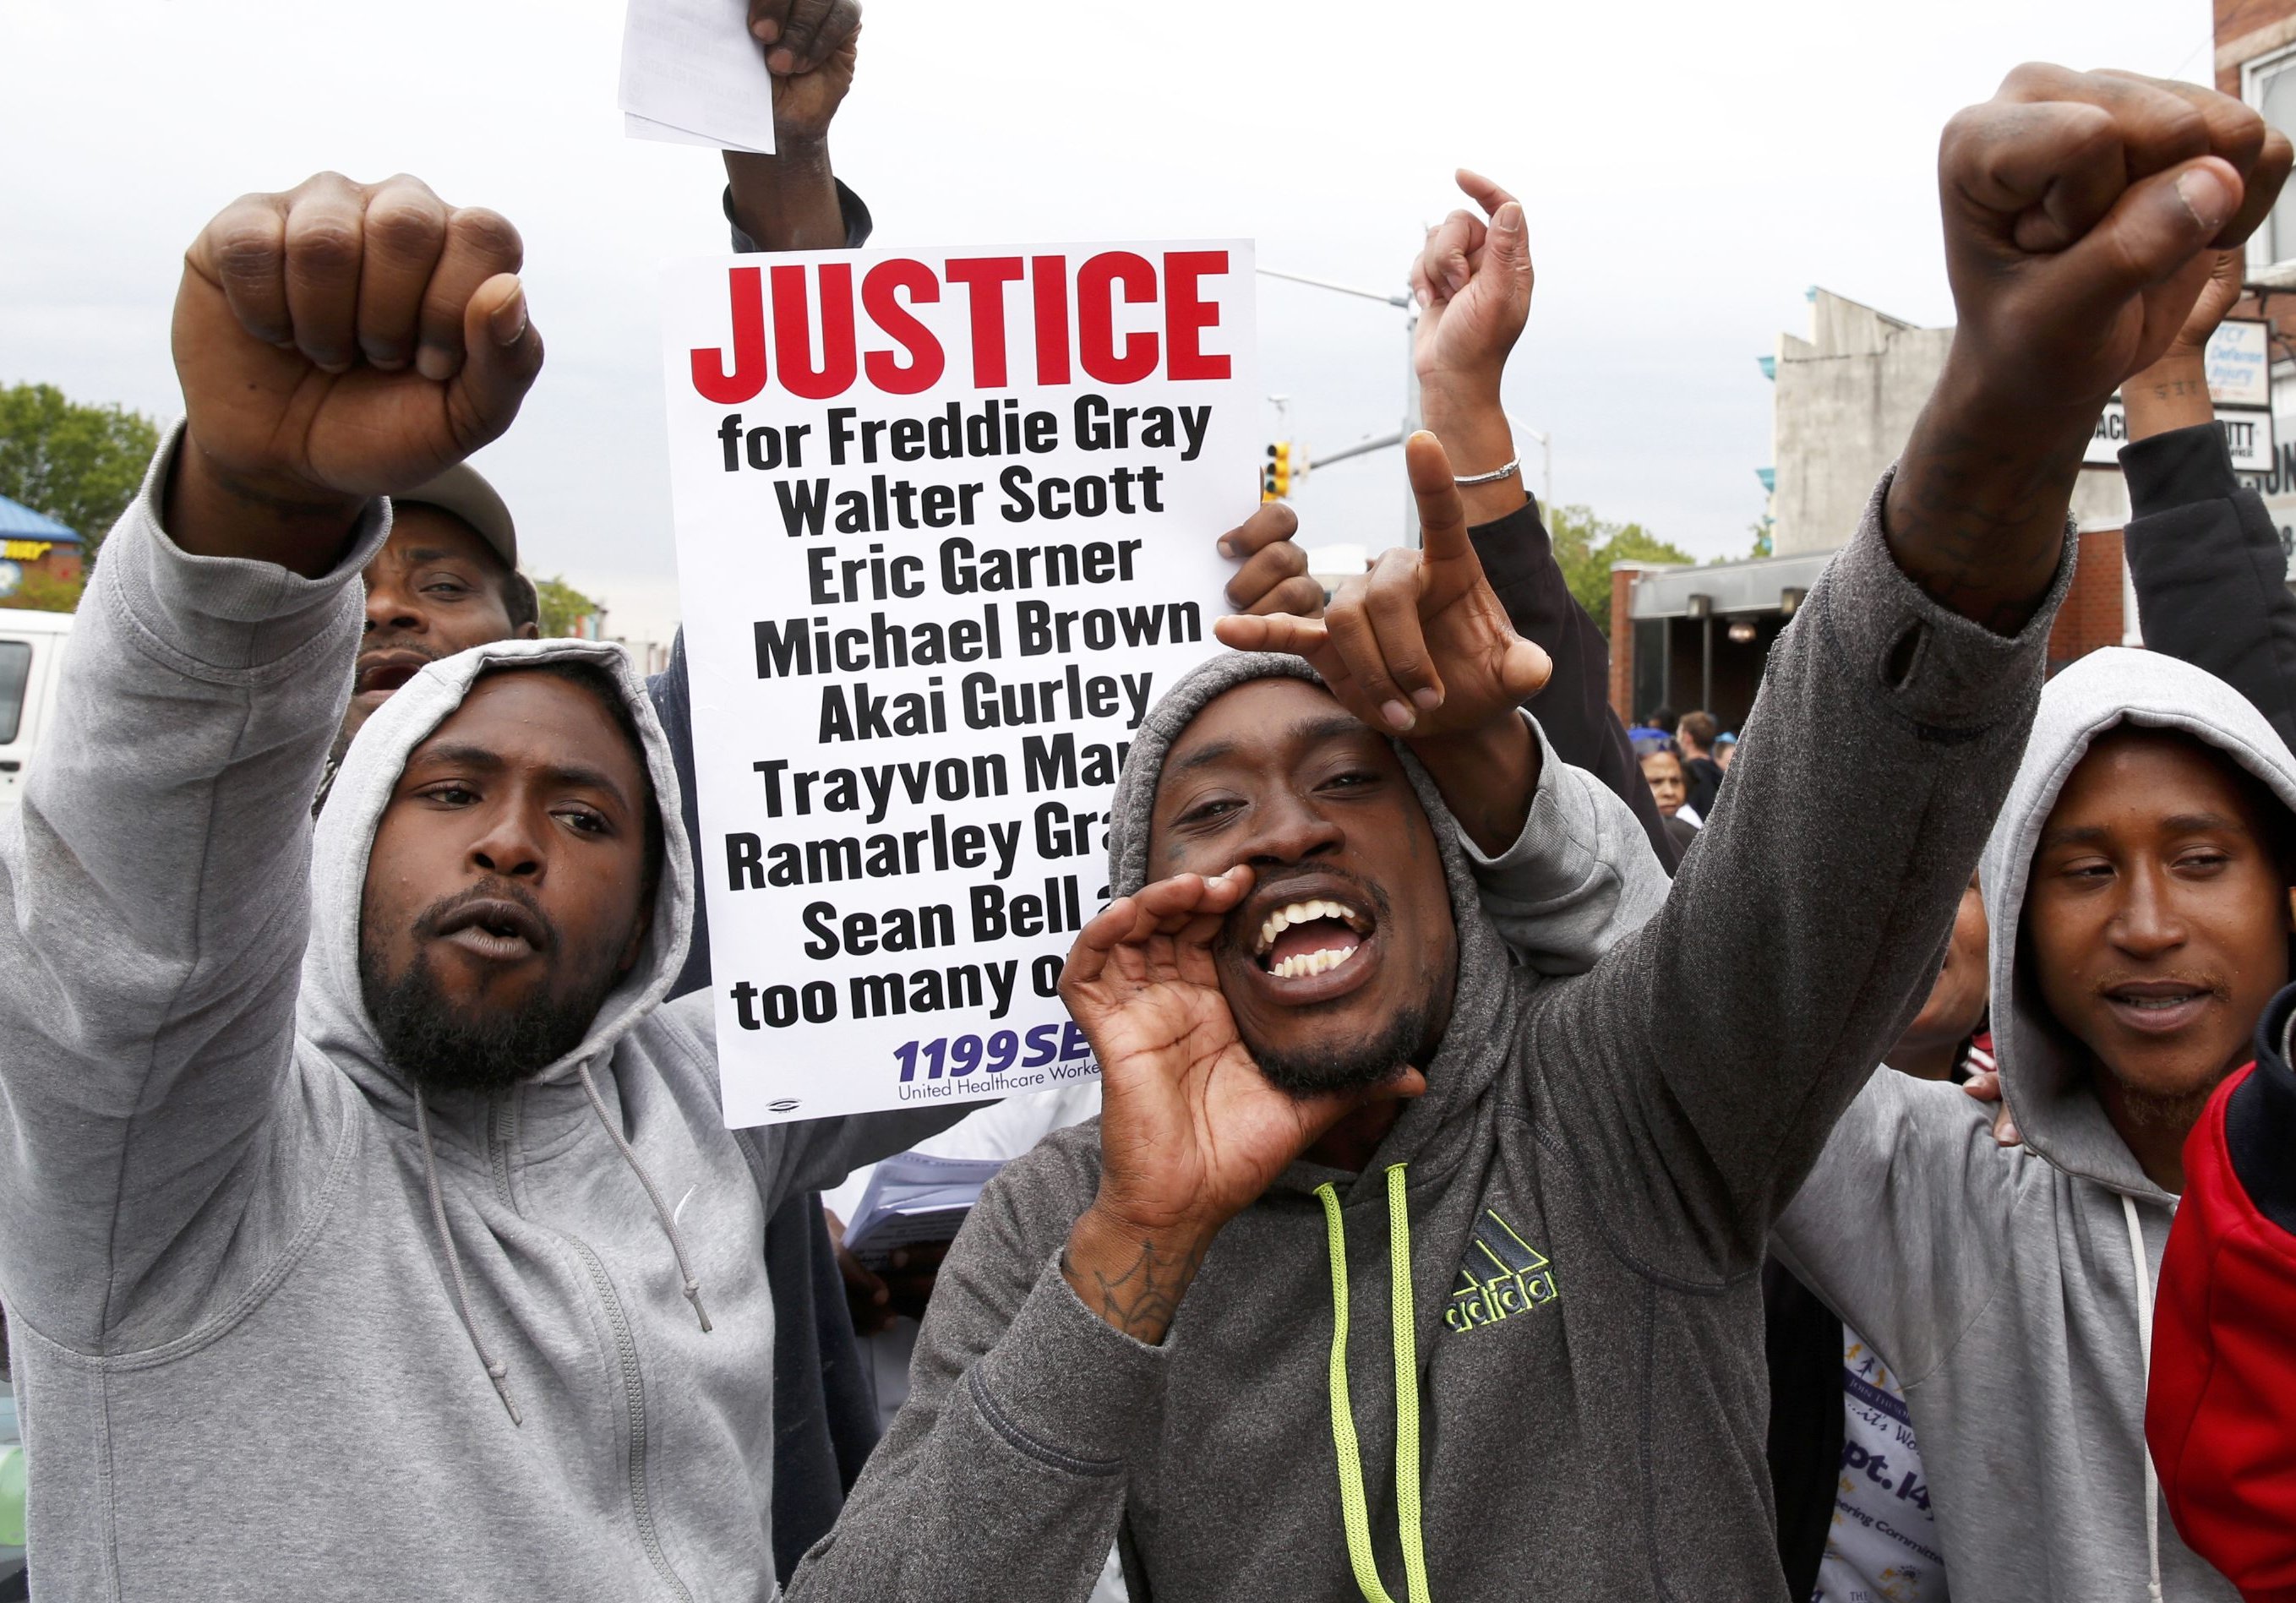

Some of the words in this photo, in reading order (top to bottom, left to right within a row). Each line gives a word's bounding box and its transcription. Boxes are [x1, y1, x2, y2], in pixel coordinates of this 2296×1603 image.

[690, 250, 1231, 405] JUSTICE
[717, 413, 811, 472] for
[827, 398, 1058, 466] Freddie
[1073, 394, 1212, 461] Gray
[773, 475, 984, 537] Walter
[999, 465, 1164, 523] Scott
[807, 543, 925, 605] Eric
[939, 537, 1142, 595] Garner
[754, 602, 1002, 679] Michael
[1016, 600, 1202, 657] Brown
[818, 677, 947, 744] Akai
[961, 664, 1153, 730] Gurley
[753, 754, 1008, 825] Trayvon
[725, 814, 1022, 891] Ramarley
[802, 901, 956, 961] Sean
[969, 875, 1082, 943] Bell
[730, 980, 837, 1031] too
[849, 959, 1018, 1020] many
[1032, 954, 1069, 998] o
[898, 1078, 952, 1100] United
[958, 1073, 1044, 1095] Healthcare
